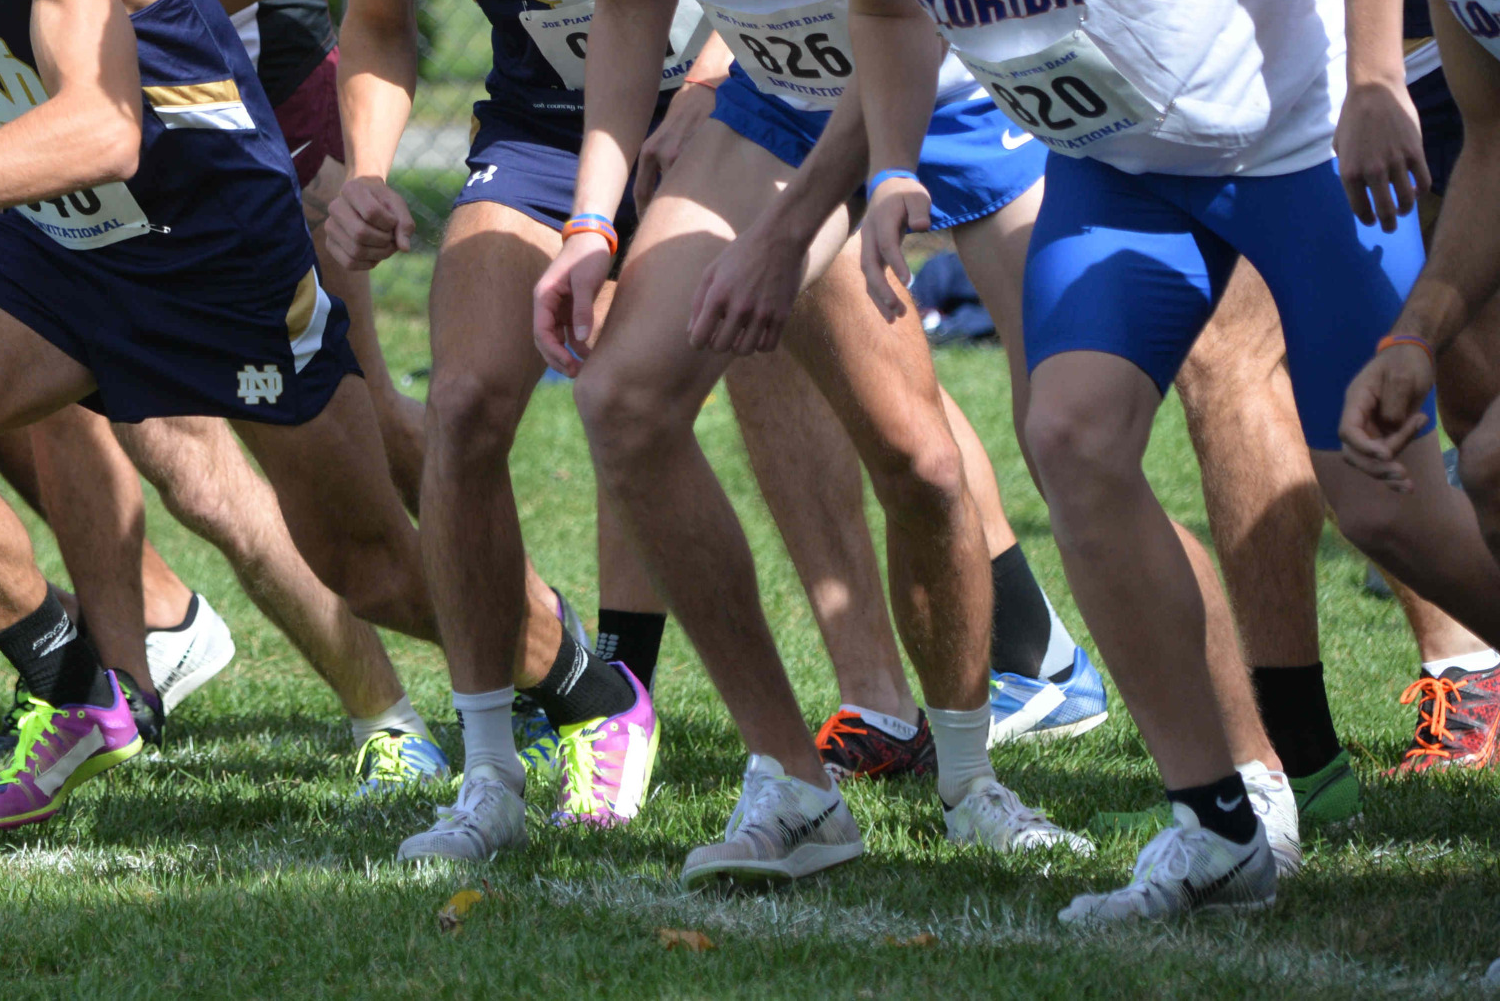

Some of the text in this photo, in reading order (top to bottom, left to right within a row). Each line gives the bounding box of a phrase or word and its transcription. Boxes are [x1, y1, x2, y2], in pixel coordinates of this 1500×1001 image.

[767, 19, 802, 31] NOTRE
[802, 12, 836, 25] DAME
[739, 32, 853, 79] 826
[1044, 50, 1078, 71] DAME
[991, 75, 1108, 131] 820
[1036, 117, 1139, 150] VITATIONAL
